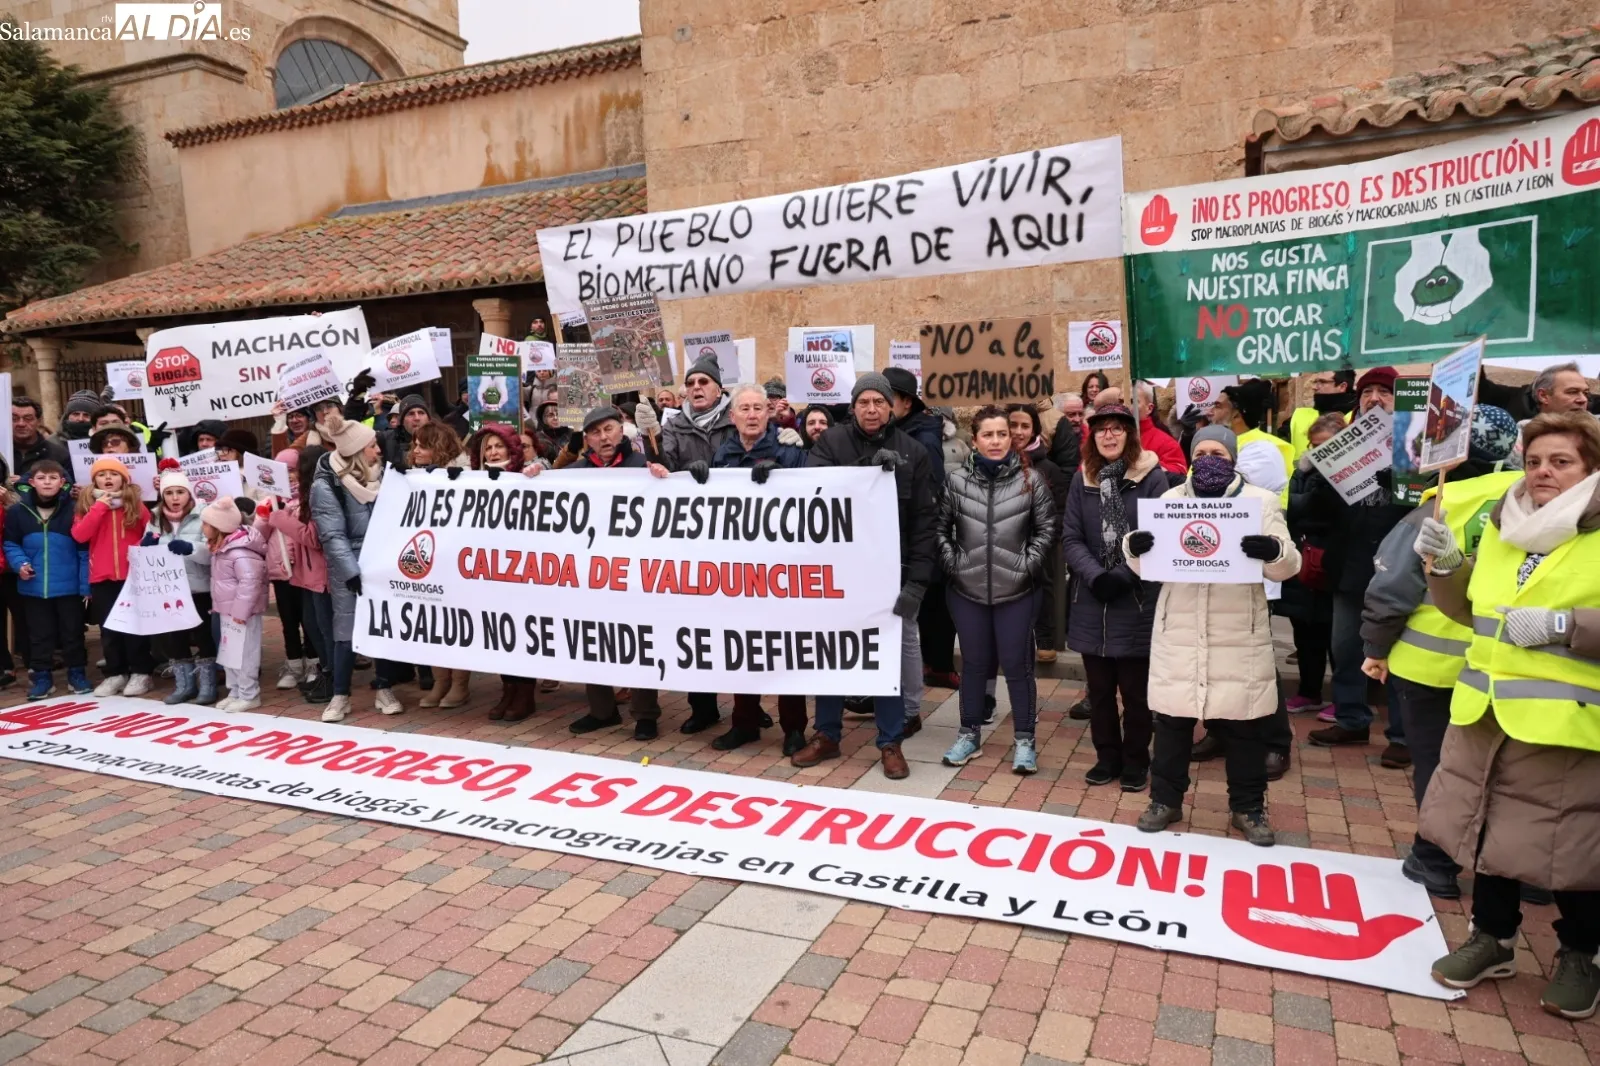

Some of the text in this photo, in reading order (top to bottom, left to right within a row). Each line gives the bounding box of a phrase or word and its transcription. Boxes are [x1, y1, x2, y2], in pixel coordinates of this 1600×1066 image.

[1192, 196, 1219, 224] ¡NO
[1222, 193, 1242, 221] ES
[1360, 174, 1383, 204] ES
[1191, 227, 1213, 242] STOP
[1215, 220, 1286, 239] MACROPLANTAS
[1291, 218, 1304, 231] DE
[1308, 210, 1344, 229] BIOGÁS
[1347, 210, 1355, 224] Y
[1356, 196, 1438, 222] MACROGRANJAS
[1445, 192, 1461, 208] EN
[1464, 181, 1513, 204] CASTILLA
[1515, 178, 1525, 193] Y
[562, 229, 594, 262] EL
[611, 204, 753, 259] PUEBLO
[769, 235, 893, 280] FUERA
[911, 226, 953, 265] DE
[986, 199, 1087, 258] AQUÍ
[1211, 243, 1327, 273] NOS GUSTA
[1186, 264, 1350, 302] NUESTRA FINCA
[1196, 303, 1323, 340] NO TOCAR
[211, 324, 360, 360] MACHACÓN
[387, 333, 422, 350] ALCORNOCAL
[807, 338, 833, 352] NO
[988, 338, 1005, 357] a
[1014, 321, 1045, 360] la
[1236, 328, 1343, 365] GRACIAS
[154, 354, 190, 369] STOP
[794, 353, 804, 363] POR
[805, 354, 813, 363] LA
[1078, 354, 1123, 364] STOP BIOGA
[238, 365, 271, 383] SIN
[613, 370, 636, 381] FINCA
[154, 381, 201, 396] Machacón
[294, 384, 340, 407] DEFIENDE
[210, 397, 228, 411] NI
[1311, 414, 1380, 463] SE DEFIENDE
[1361, 430, 1378, 442] SALUD
[131, 456, 148, 464] PLATA
[1360, 448, 1383, 465] CALZADA
[207, 466, 214, 474] LA
[214, 464, 231, 473] PLATA
[1201, 502, 1233, 510] SALUD
[400, 487, 854, 549] NO ES PROGRESO, ES DESTRUCCIÓN
[145, 555, 166, 568] UN
[1172, 559, 1230, 568] STOP BIOGAS
[457, 547, 845, 599] CALZADA DE VALDUNCIEL
[389, 580, 444, 595] STOP BIOGAS
[368, 598, 880, 682] LA SALUD NO SE VENDE, SE DEFIENDE
[151, 722, 254, 748] ES
[215, 730, 532, 801] PROGRESO,
[530, 772, 637, 808] ES
[621, 784, 1209, 897] DESTRUCCIÓN!
[8, 740, 1189, 939] STOP macroplantas de biogás y macrogranjas en Castilla y León
